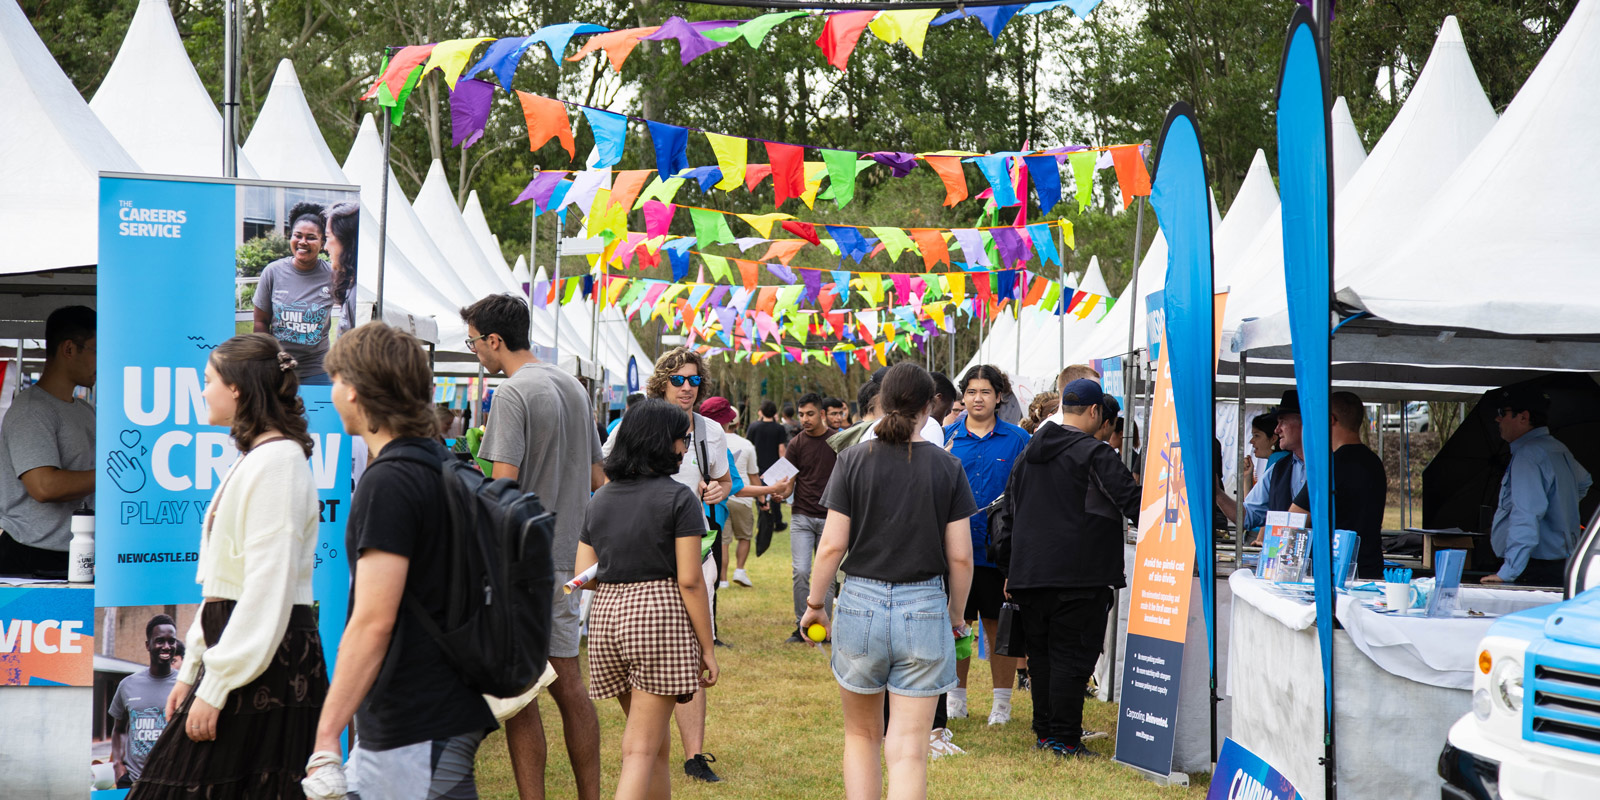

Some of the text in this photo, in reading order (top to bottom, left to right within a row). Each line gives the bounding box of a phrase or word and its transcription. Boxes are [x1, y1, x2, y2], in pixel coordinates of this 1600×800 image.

[119, 200, 133, 208] THE
[119, 208, 187, 224] CAREERS
[119, 222, 181, 238] SERVICE
[281, 311, 303, 323] UNI
[286, 322, 319, 333] CREW
[123, 366, 209, 426] UN
[120, 501, 189, 525] PLAY
[117, 552, 199, 564] NEWCASTLE.ED
[135, 718, 155, 730] UNI
